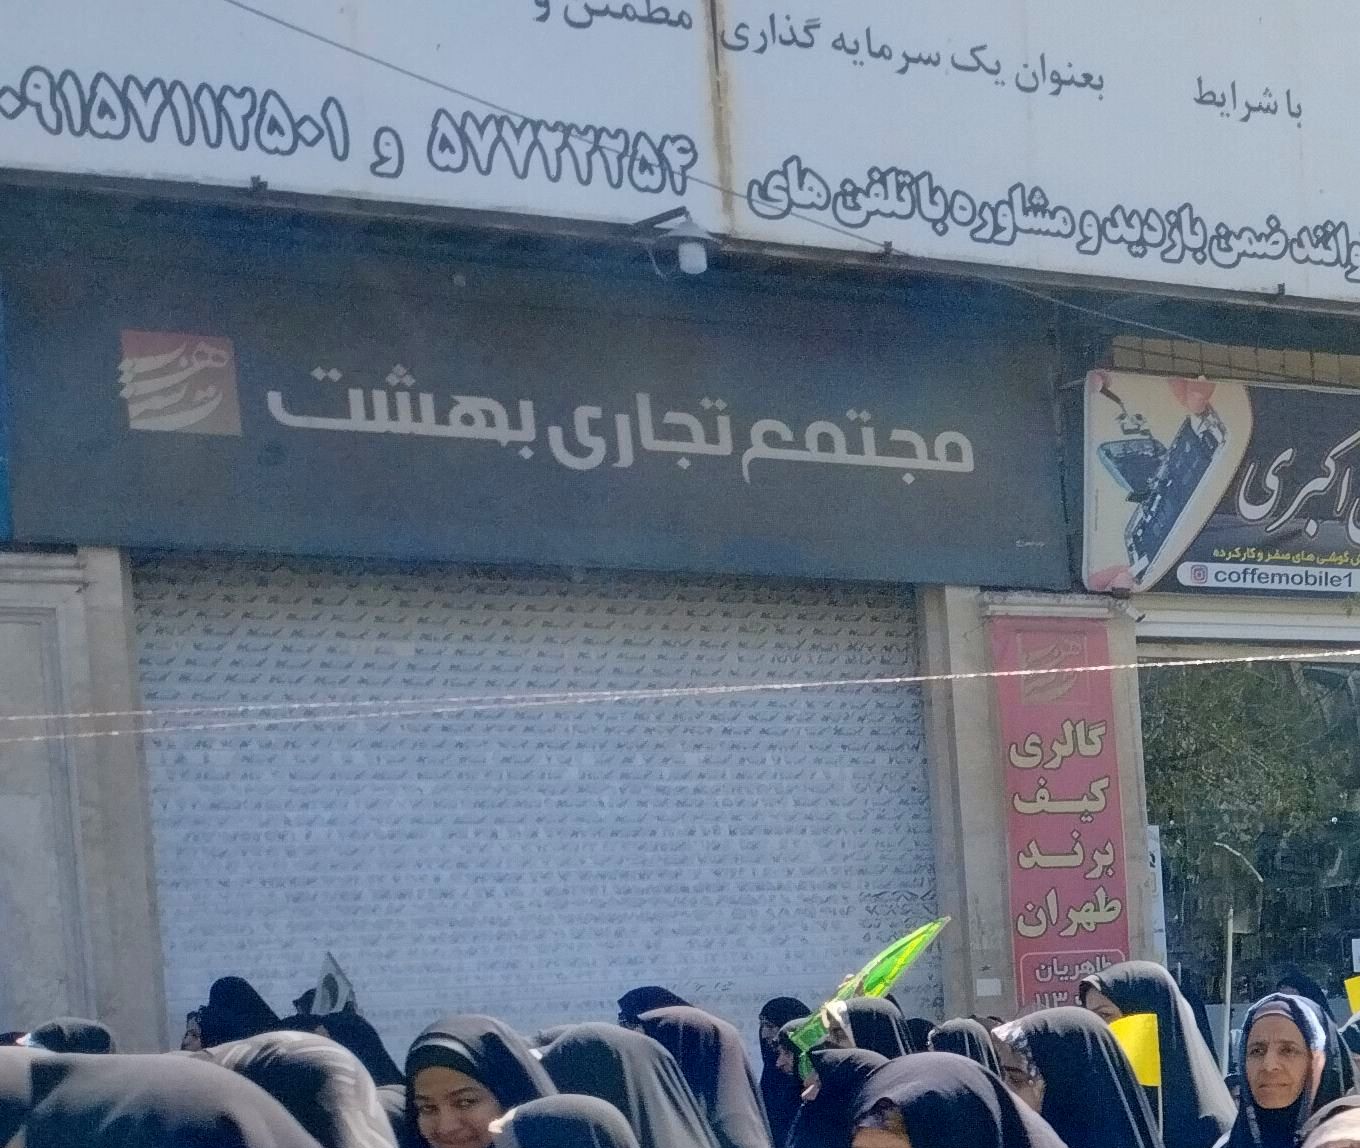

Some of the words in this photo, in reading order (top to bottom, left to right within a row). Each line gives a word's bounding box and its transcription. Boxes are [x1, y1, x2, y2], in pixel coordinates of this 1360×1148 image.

[950, 44, 1006, 88] یک
[1014, 52, 1105, 102] بعنوان
[369, 125, 405, 180] و
[747, 154, 832, 220] های
[832, 165, 917, 229] تلفن
[949, 181, 1076, 246] مشاوره
[1076, 209, 1101, 256] و
[1101, 202, 1208, 265] بازدید
[1208, 213, 1289, 270] ضمن
[265, 362, 537, 461] بهشت
[547, 390, 733, 471] تجاری
[742, 408, 976, 485] مجتمع
[1213, 566, 1354, 589] coffemobile1
[1008, 719, 1108, 770] گالری
[1012, 775, 1111, 823] کیف
[1016, 830, 1116, 880] برند
[1015, 886, 1123, 938] طهران
